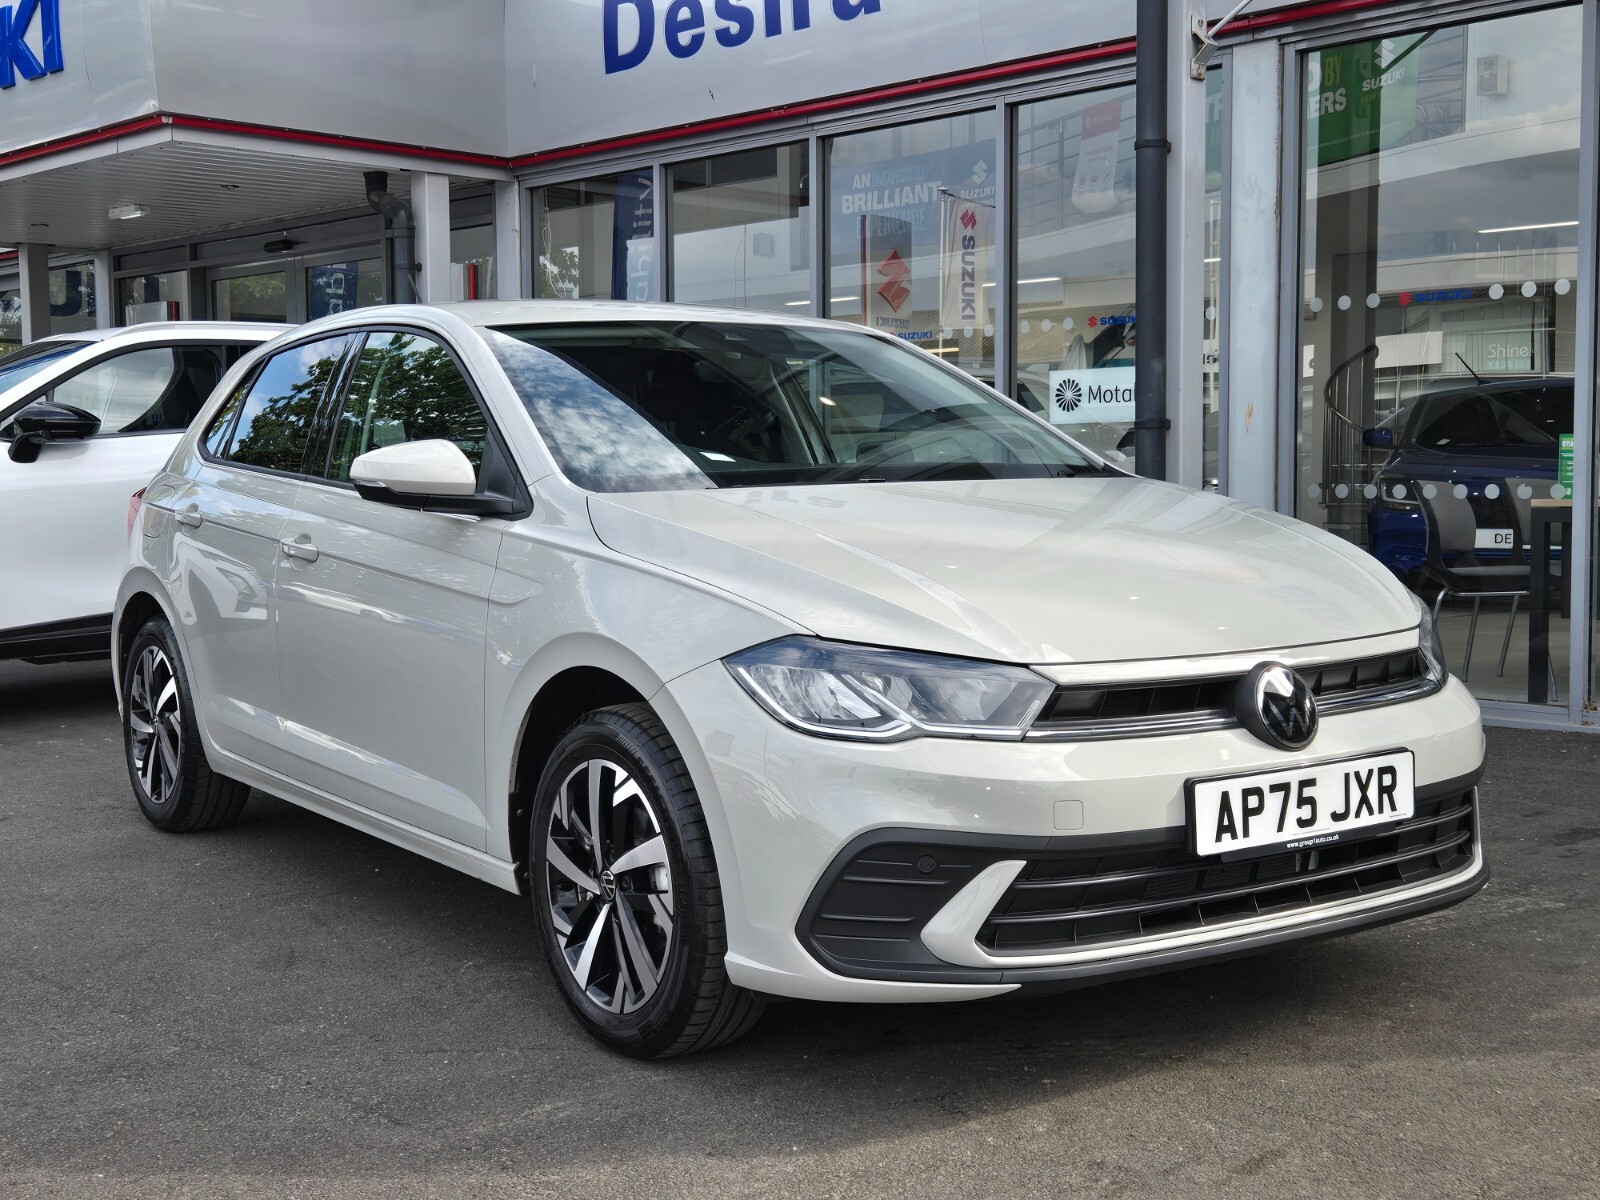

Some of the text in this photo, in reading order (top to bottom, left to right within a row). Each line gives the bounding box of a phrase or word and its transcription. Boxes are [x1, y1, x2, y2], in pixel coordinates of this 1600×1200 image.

[1362, 68, 1405, 92] SUZUKI
[852, 173, 871, 190] AN
[841, 181, 942, 214] BRILLIANT
[960, 185, 995, 200] SUZUKI
[961, 234, 976, 321] SUZUKI
[1414, 289, 1472, 303] SUZUKI
[898, 330, 933, 340] SUZUKI
[1088, 385, 1136, 404] Mota
[1215, 765, 1398, 843] AP75 JXR
